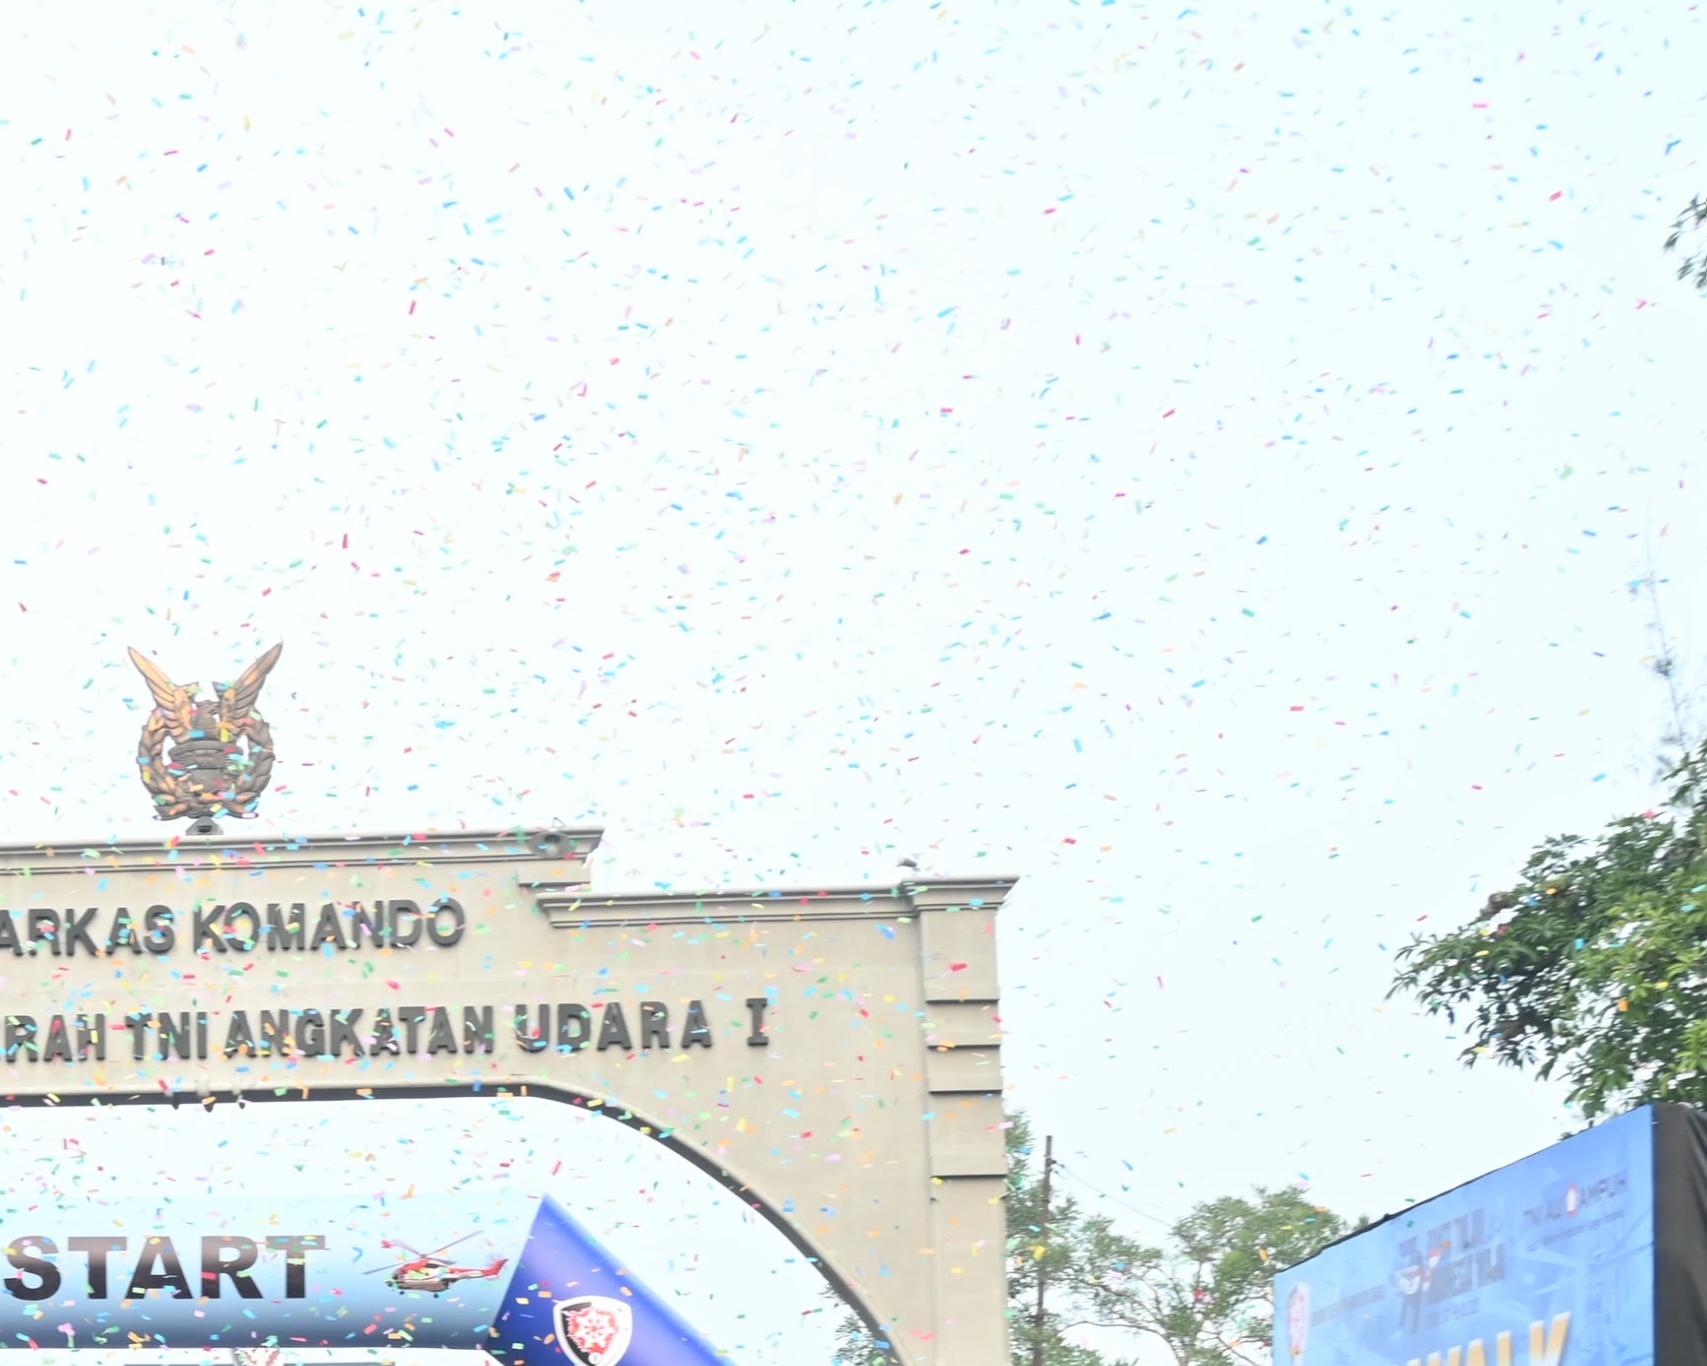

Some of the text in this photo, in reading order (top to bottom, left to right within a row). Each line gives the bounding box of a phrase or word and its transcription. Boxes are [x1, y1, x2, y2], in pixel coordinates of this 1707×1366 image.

[193, 897, 466, 953] KOMANDO
[127, 1009, 208, 1060] TNI
[225, 1005, 494, 1059] ANGKATAN
[514, 1000, 713, 1053] UDARA
[745, 997, 769, 1047] I
[2, 1234, 326, 1301] START
